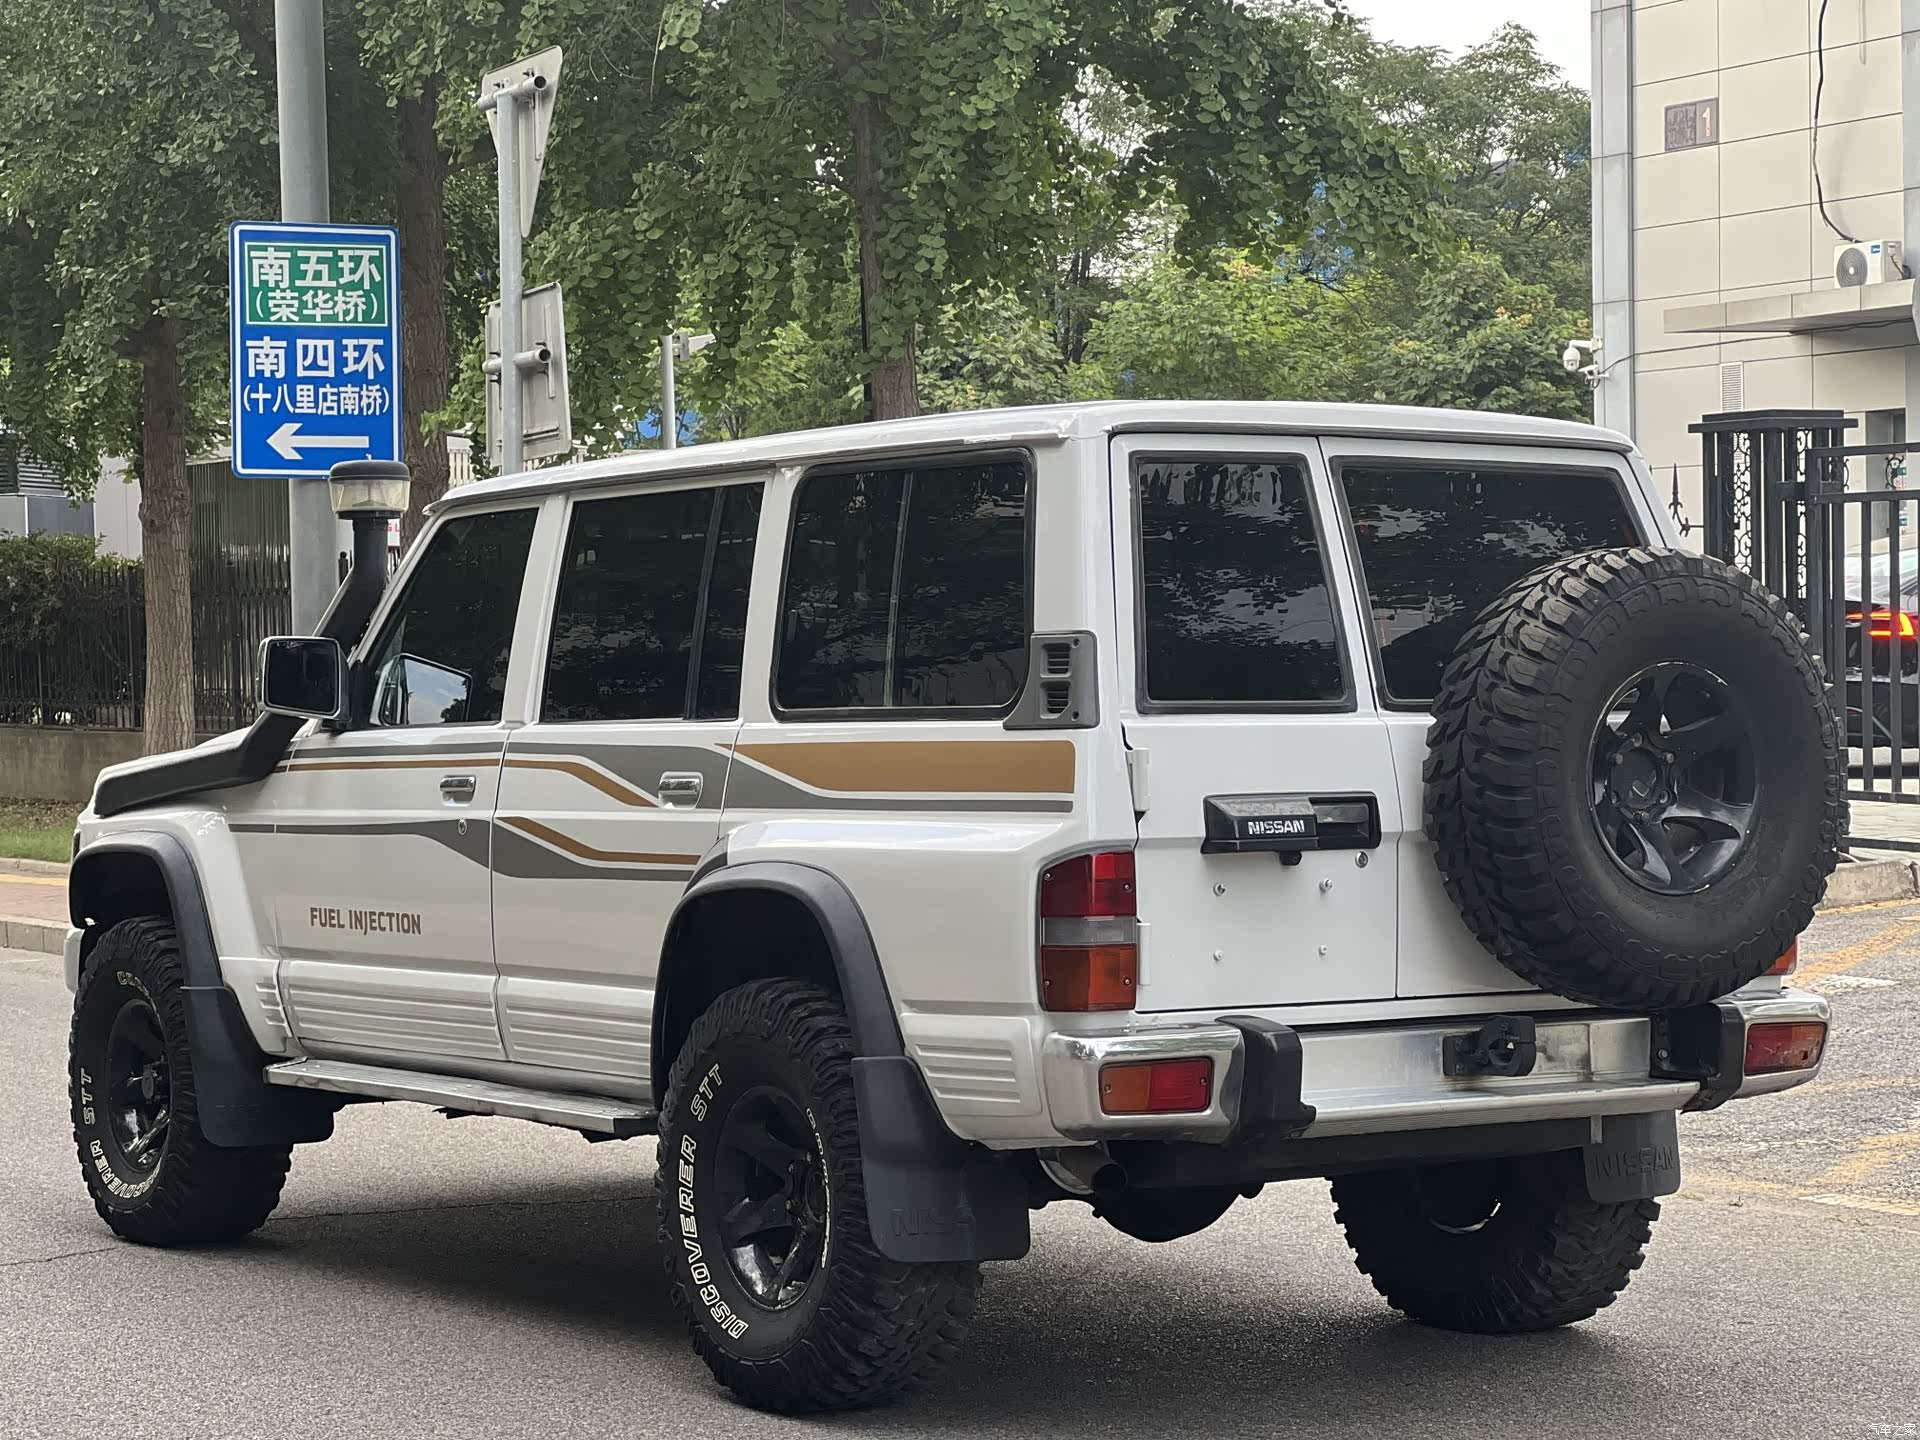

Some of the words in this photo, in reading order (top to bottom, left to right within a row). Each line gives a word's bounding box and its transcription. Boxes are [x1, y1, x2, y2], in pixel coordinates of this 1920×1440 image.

[250, 247, 381, 290] 南五环
[256, 289, 378, 322] (荣华桥)
[245, 336, 385, 380] 南四环
[243, 382, 390, 416] (十八里店南桥)
[1247, 819, 1305, 835] NISSAN
[310, 906, 345, 929] FUEL
[348, 909, 422, 935] INJECTION
[80, 1067, 96, 1125] STT
[691, 1063, 723, 1122] STT
[678, 1134, 749, 1339] DISCOVERER
